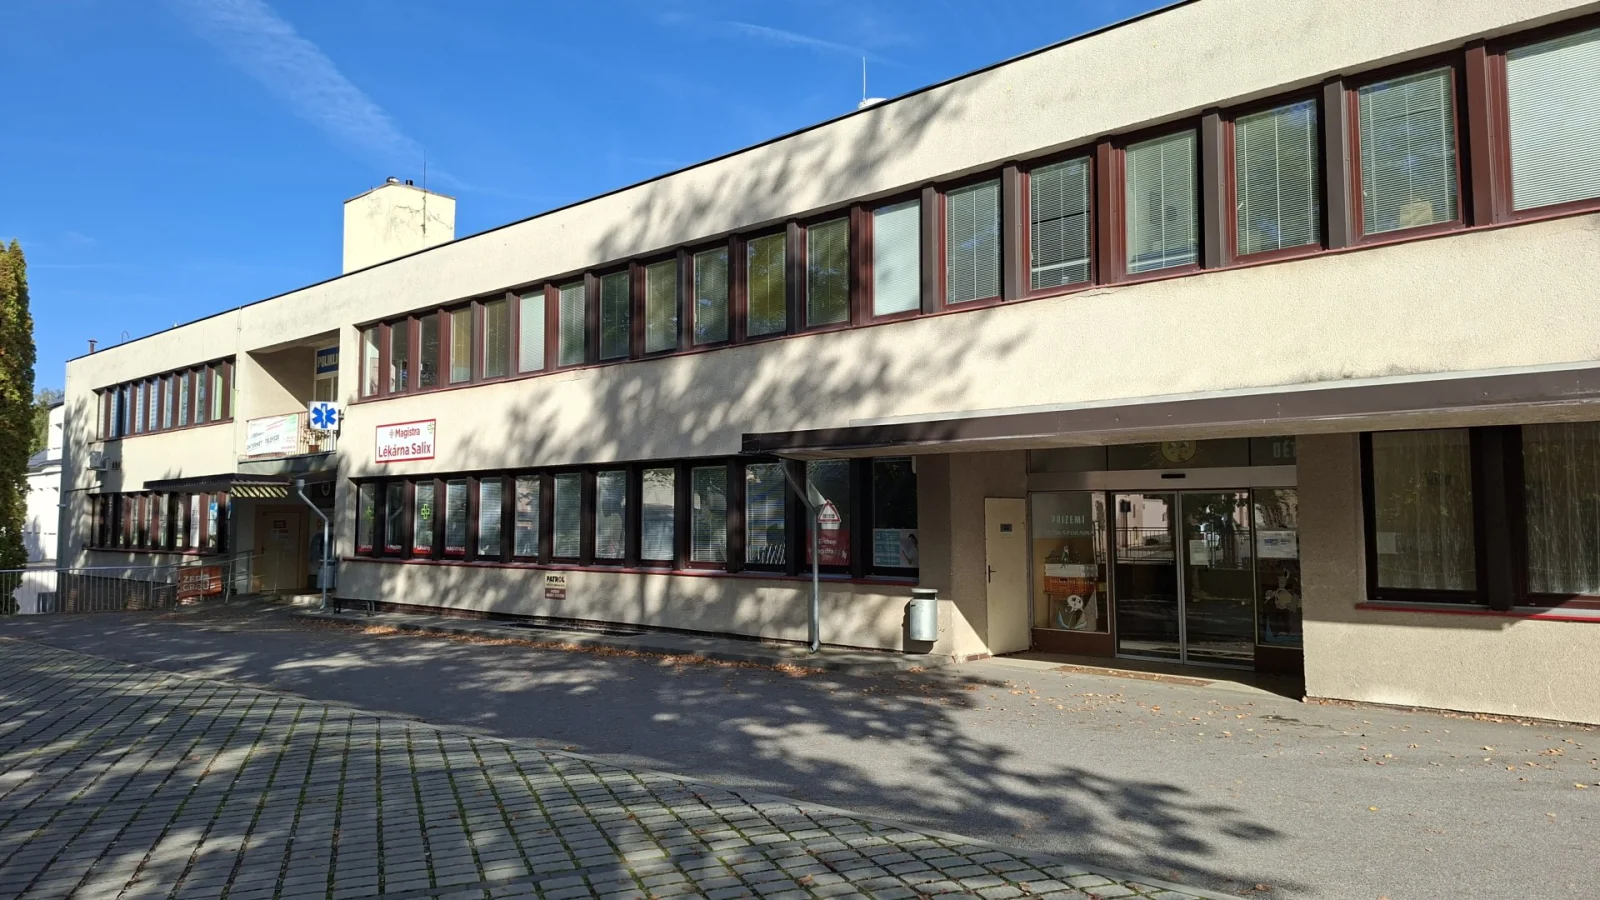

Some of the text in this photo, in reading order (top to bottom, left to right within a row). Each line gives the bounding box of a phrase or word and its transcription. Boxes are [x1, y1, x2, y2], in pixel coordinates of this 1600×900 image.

[394, 426, 421, 439] Magistra
[378, 441, 431, 458] Lékárna Salix
